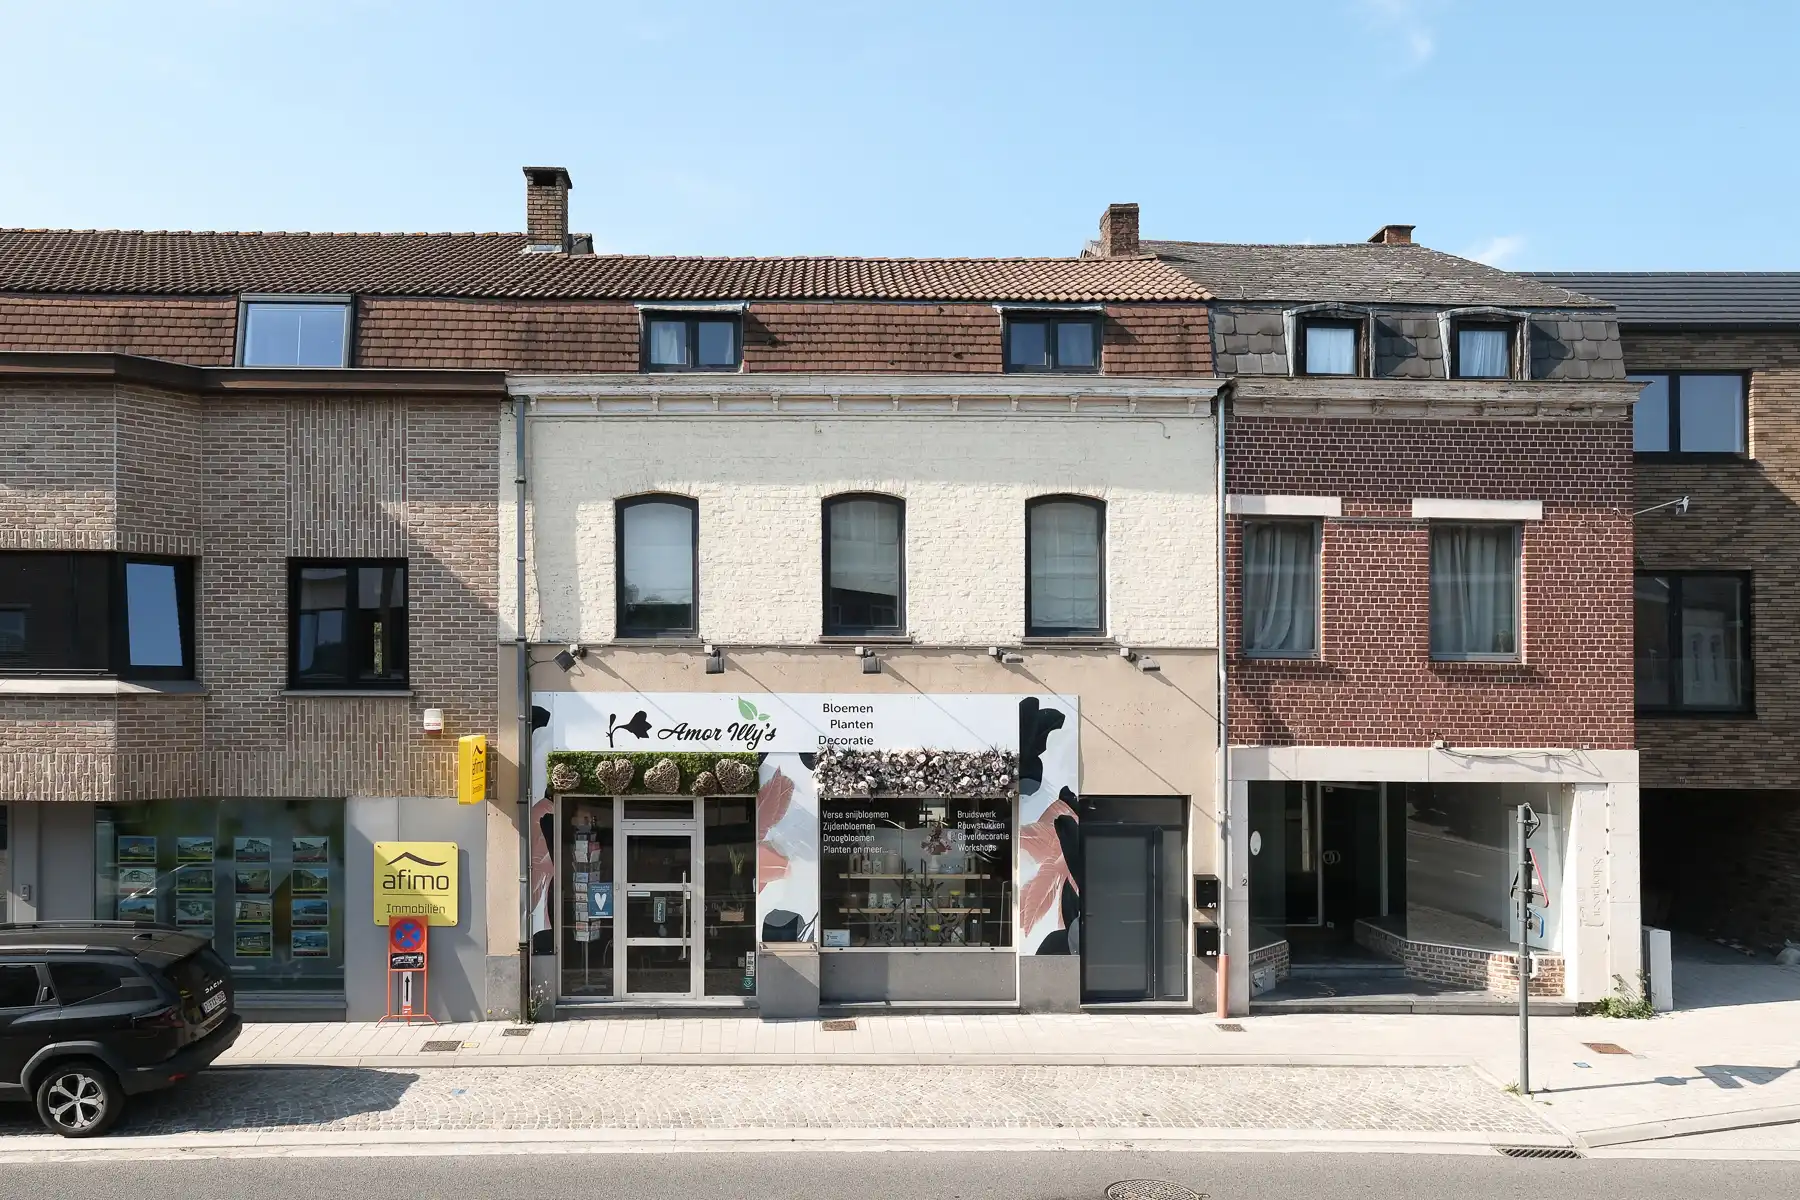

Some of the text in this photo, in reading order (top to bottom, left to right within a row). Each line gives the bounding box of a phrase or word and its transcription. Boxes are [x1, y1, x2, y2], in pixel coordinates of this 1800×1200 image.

[823, 703, 873, 713] Bloemen
[830, 719, 873, 729] Planten
[657, 722, 776, 750] Amor Illy's
[818, 735, 874, 746] Decoratie
[845, 811, 889, 819] snijbloemen
[823, 822, 876, 831] Zijdenbloemen
[823, 834, 874, 843] Droogbloemen
[382, 869, 449, 890] afimo
[386, 903, 446, 914] Immobiliën
[204, 980, 223, 994] DACIA
